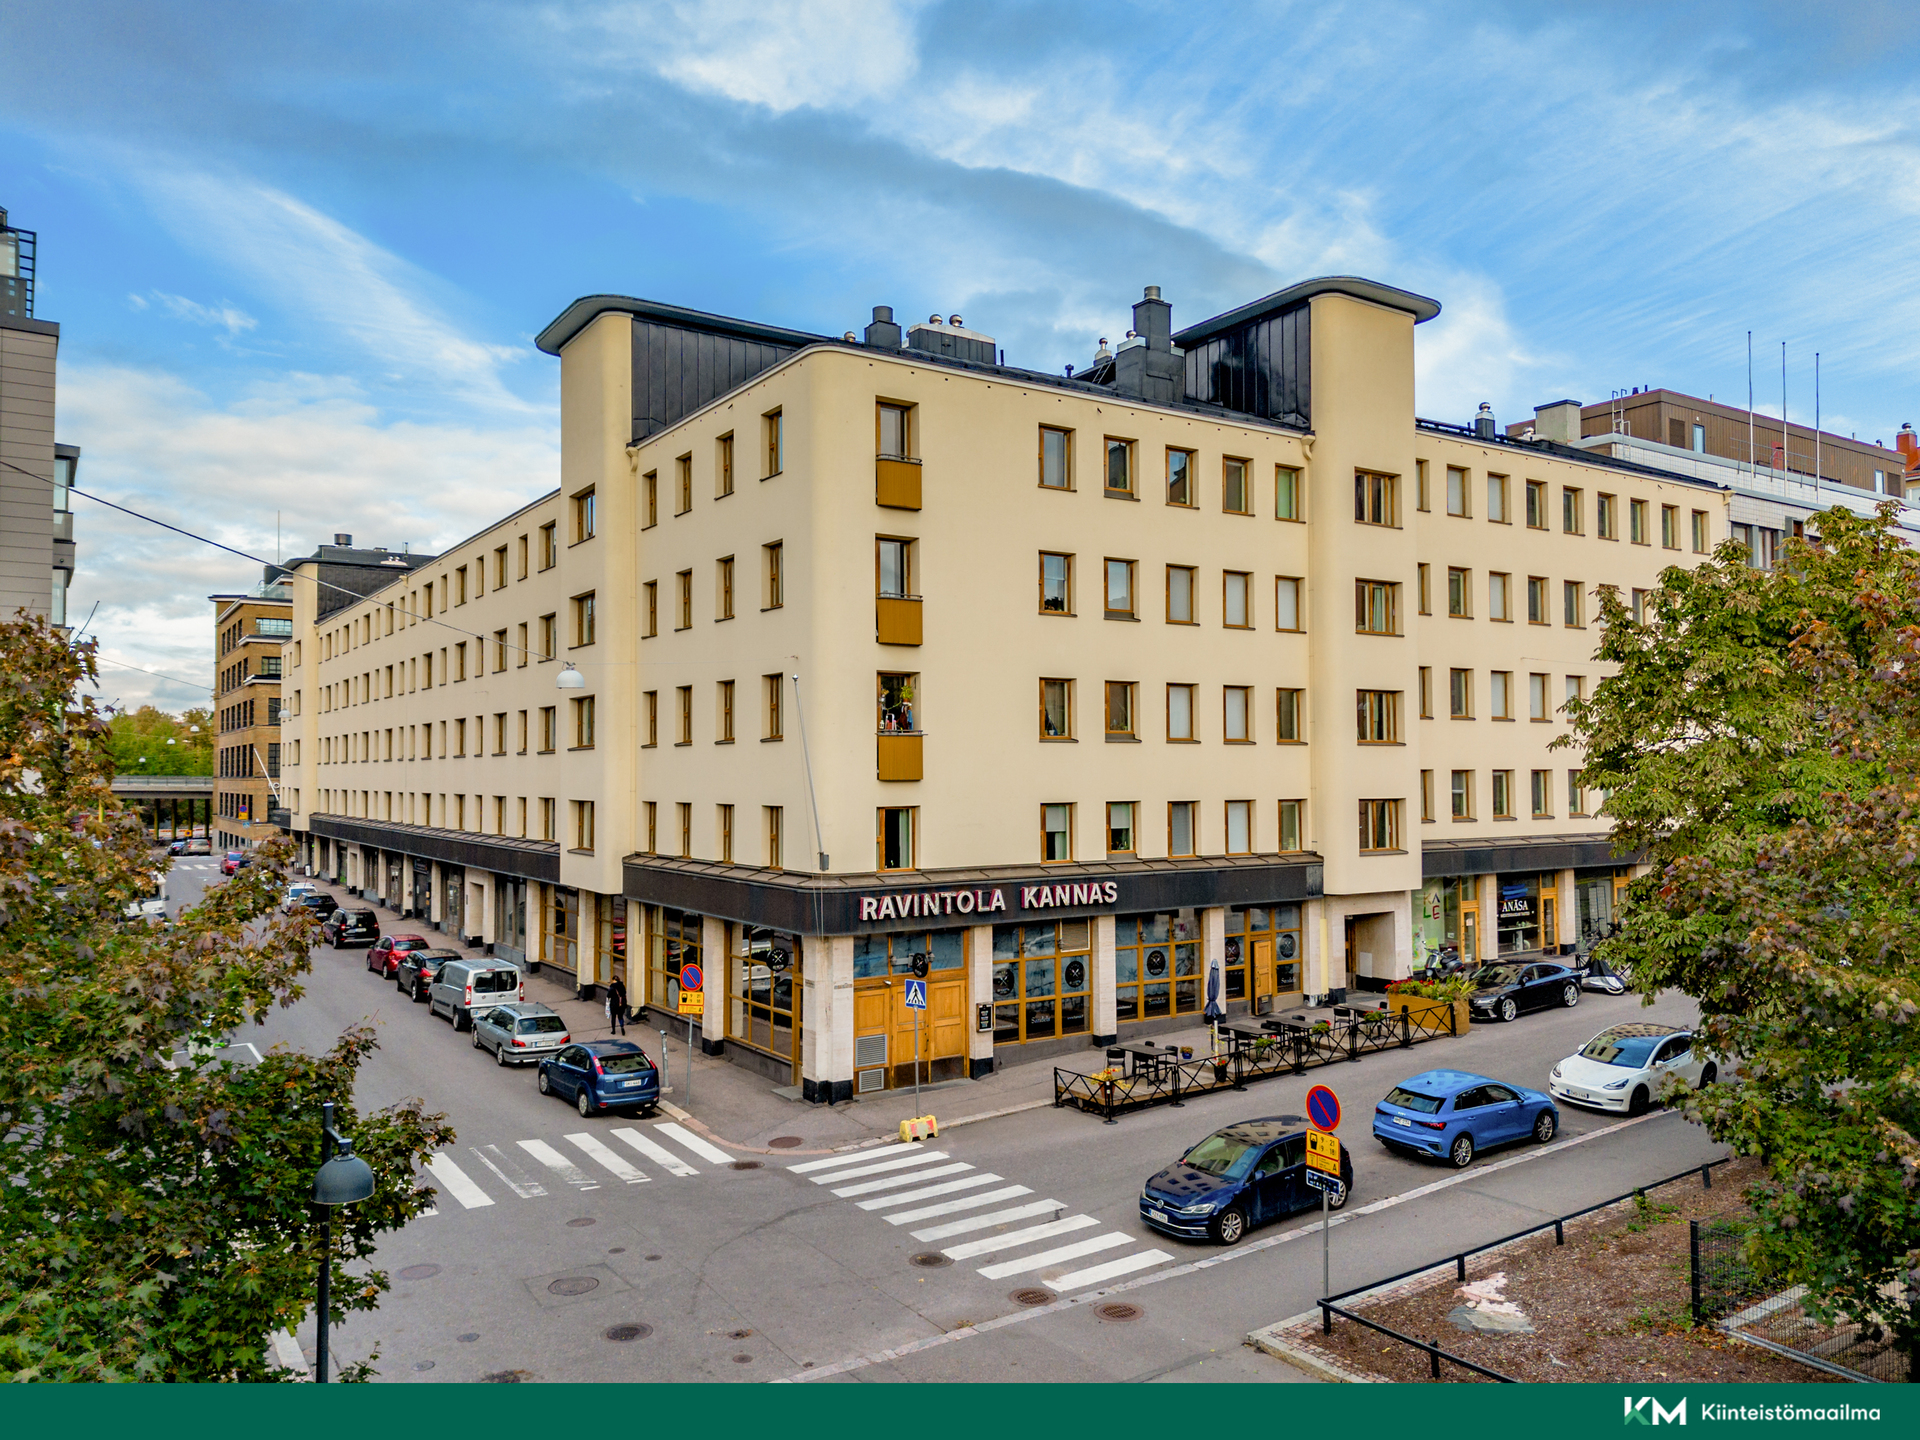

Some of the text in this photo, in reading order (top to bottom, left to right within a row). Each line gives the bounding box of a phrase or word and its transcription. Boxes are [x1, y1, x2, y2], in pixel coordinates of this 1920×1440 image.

[859, 881, 1118, 921] RAVINTOLA KANNAS
[1329, 1139, 1335, 1147] 21
